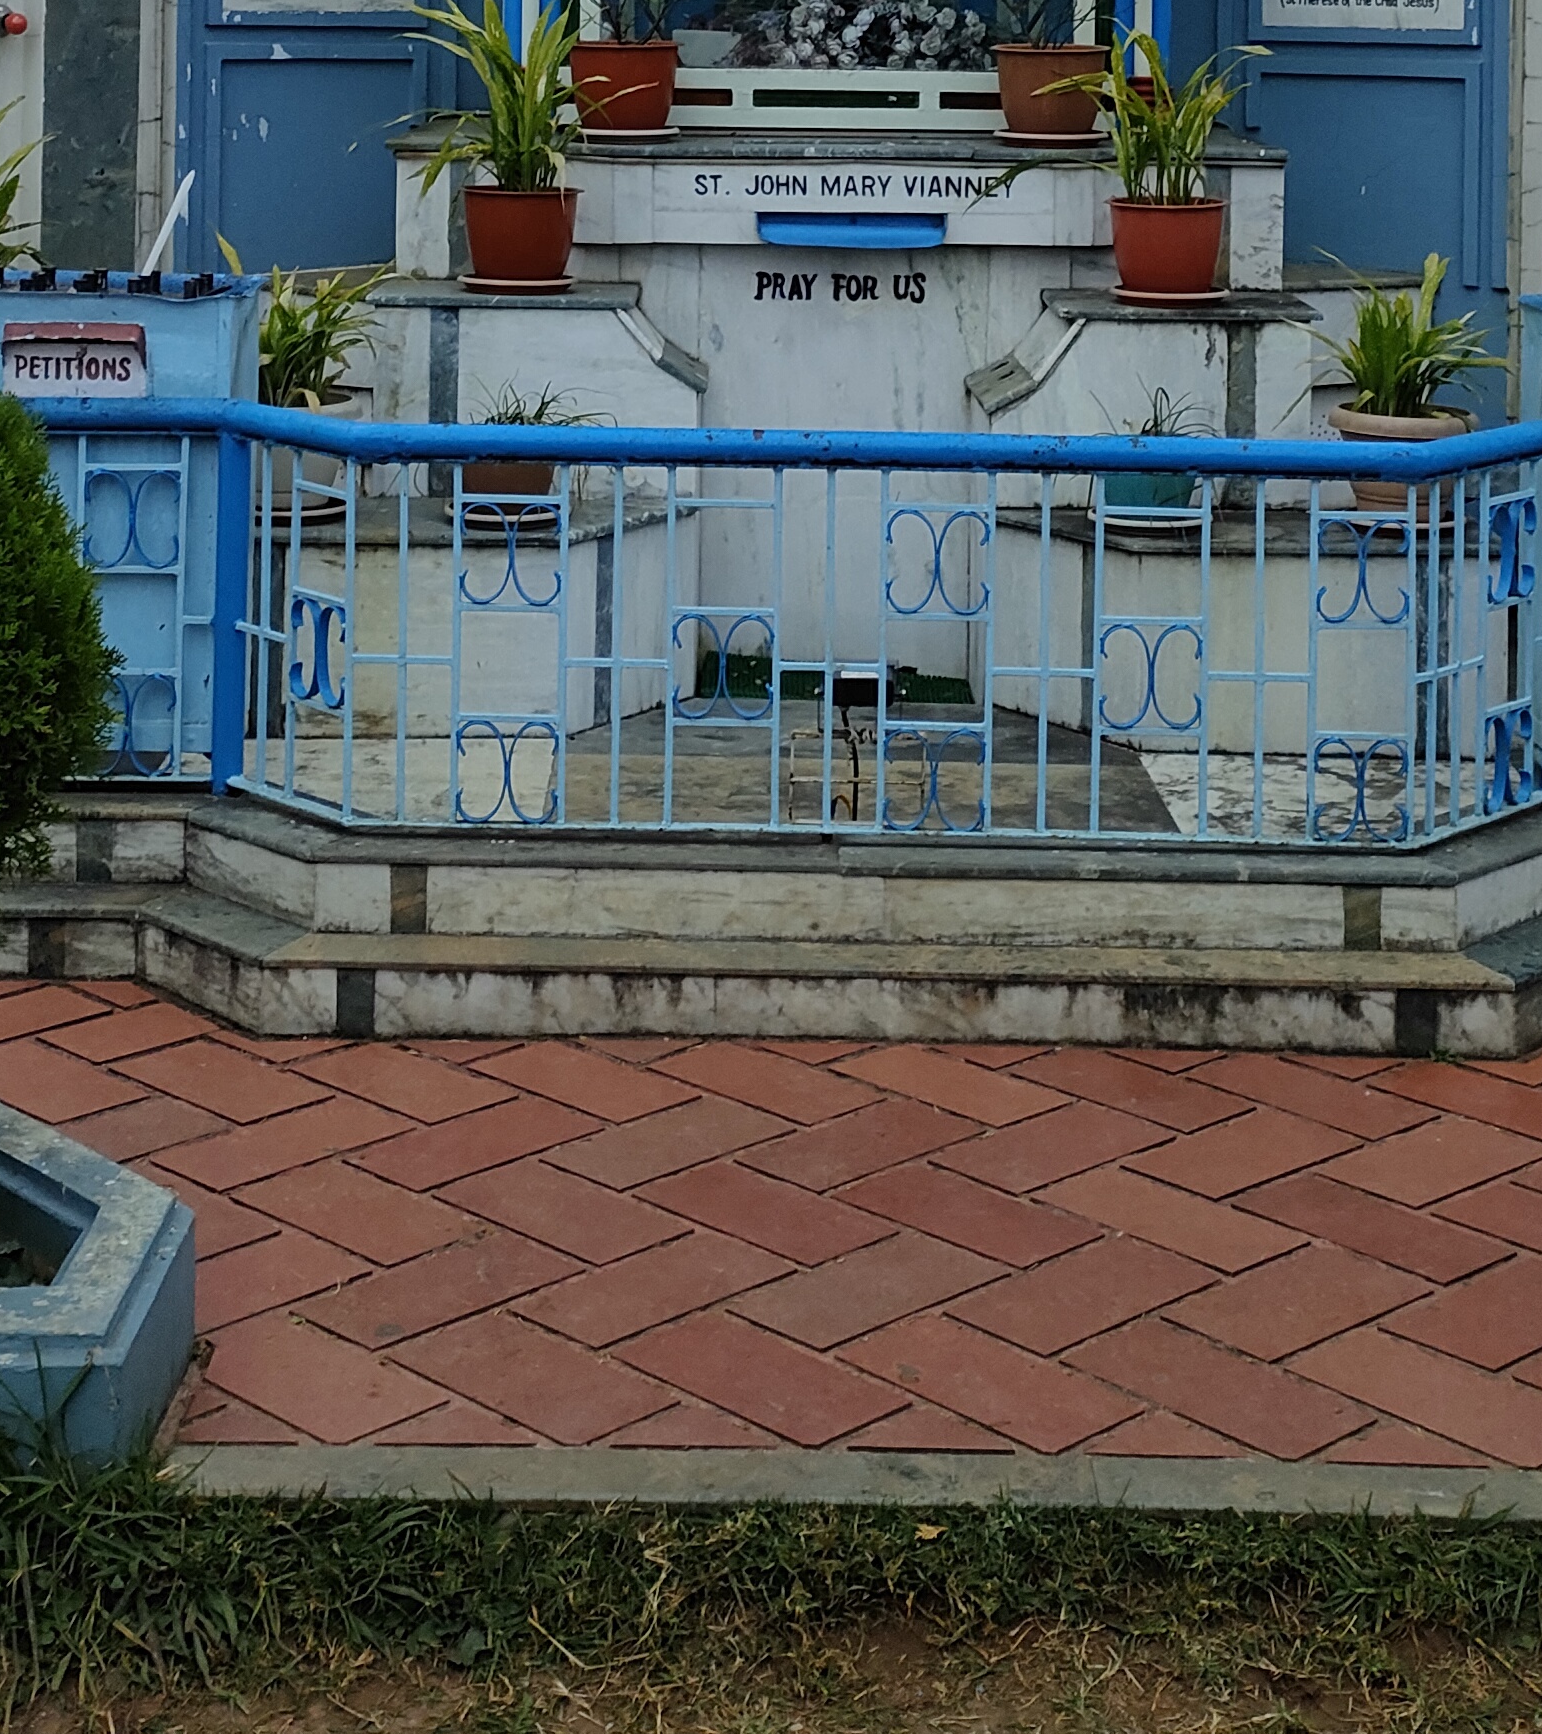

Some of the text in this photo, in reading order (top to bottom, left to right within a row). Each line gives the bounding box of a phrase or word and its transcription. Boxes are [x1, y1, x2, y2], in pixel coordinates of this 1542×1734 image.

[693, 173, 1015, 199] ST. JOHN MARY VIANNEY
[754, 271, 926, 304] PRAY FOR US
[14, 354, 132, 382] PETITIONS
